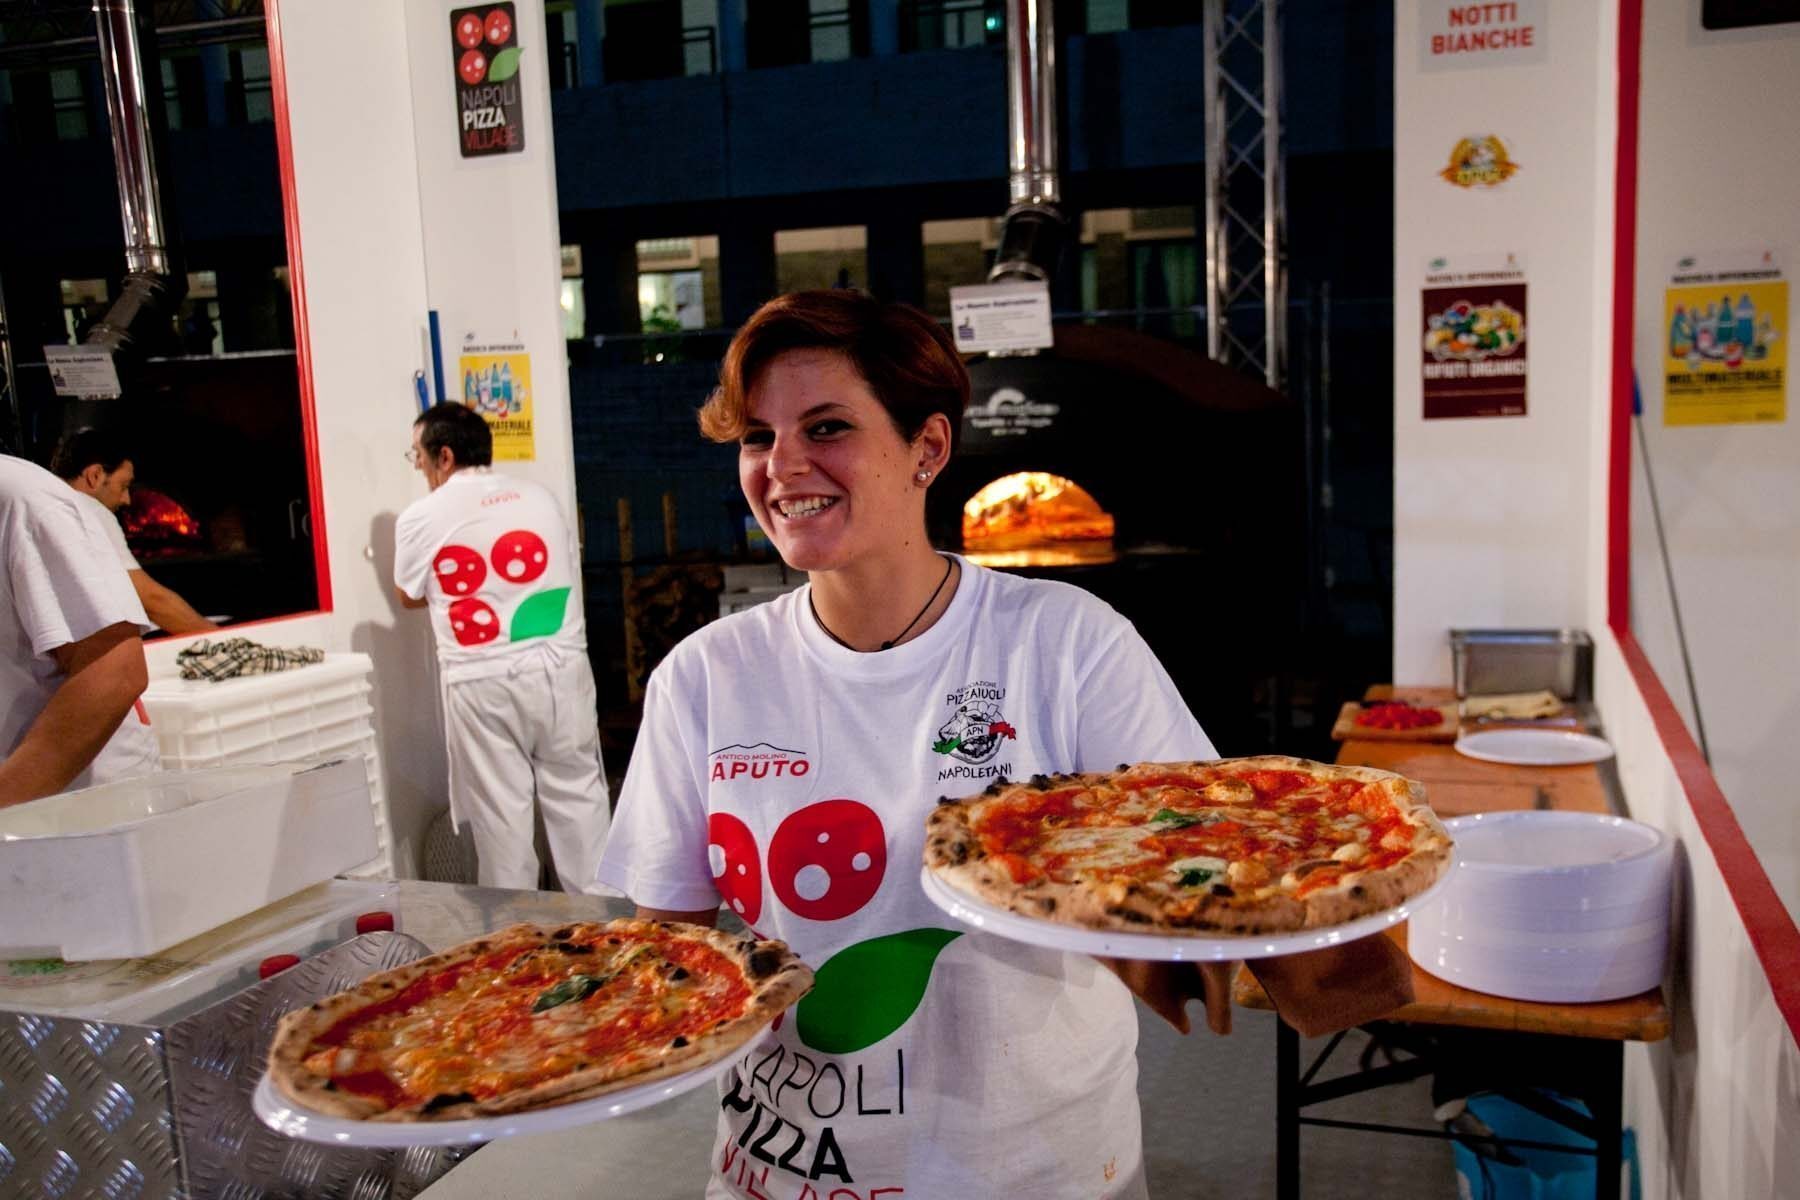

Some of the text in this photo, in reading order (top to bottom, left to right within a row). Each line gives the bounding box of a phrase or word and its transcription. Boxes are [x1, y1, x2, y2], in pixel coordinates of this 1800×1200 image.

[1449, 2, 1517, 27] NOTTI
[1432, 27, 1534, 54] BIANCHE
[462, 84, 516, 109] NAPOLI
[463, 106, 506, 131] PIZZA
[465, 124, 519, 149] VILLAGE
[488, 420, 531, 431] MATERIALE
[966, 726, 984, 738] APN
[716, 753, 750, 761] ANTICO
[711, 759, 809, 782] APUTO
[938, 762, 1012, 781] NAPOLETANI
[744, 1044, 905, 1119] APOLI
